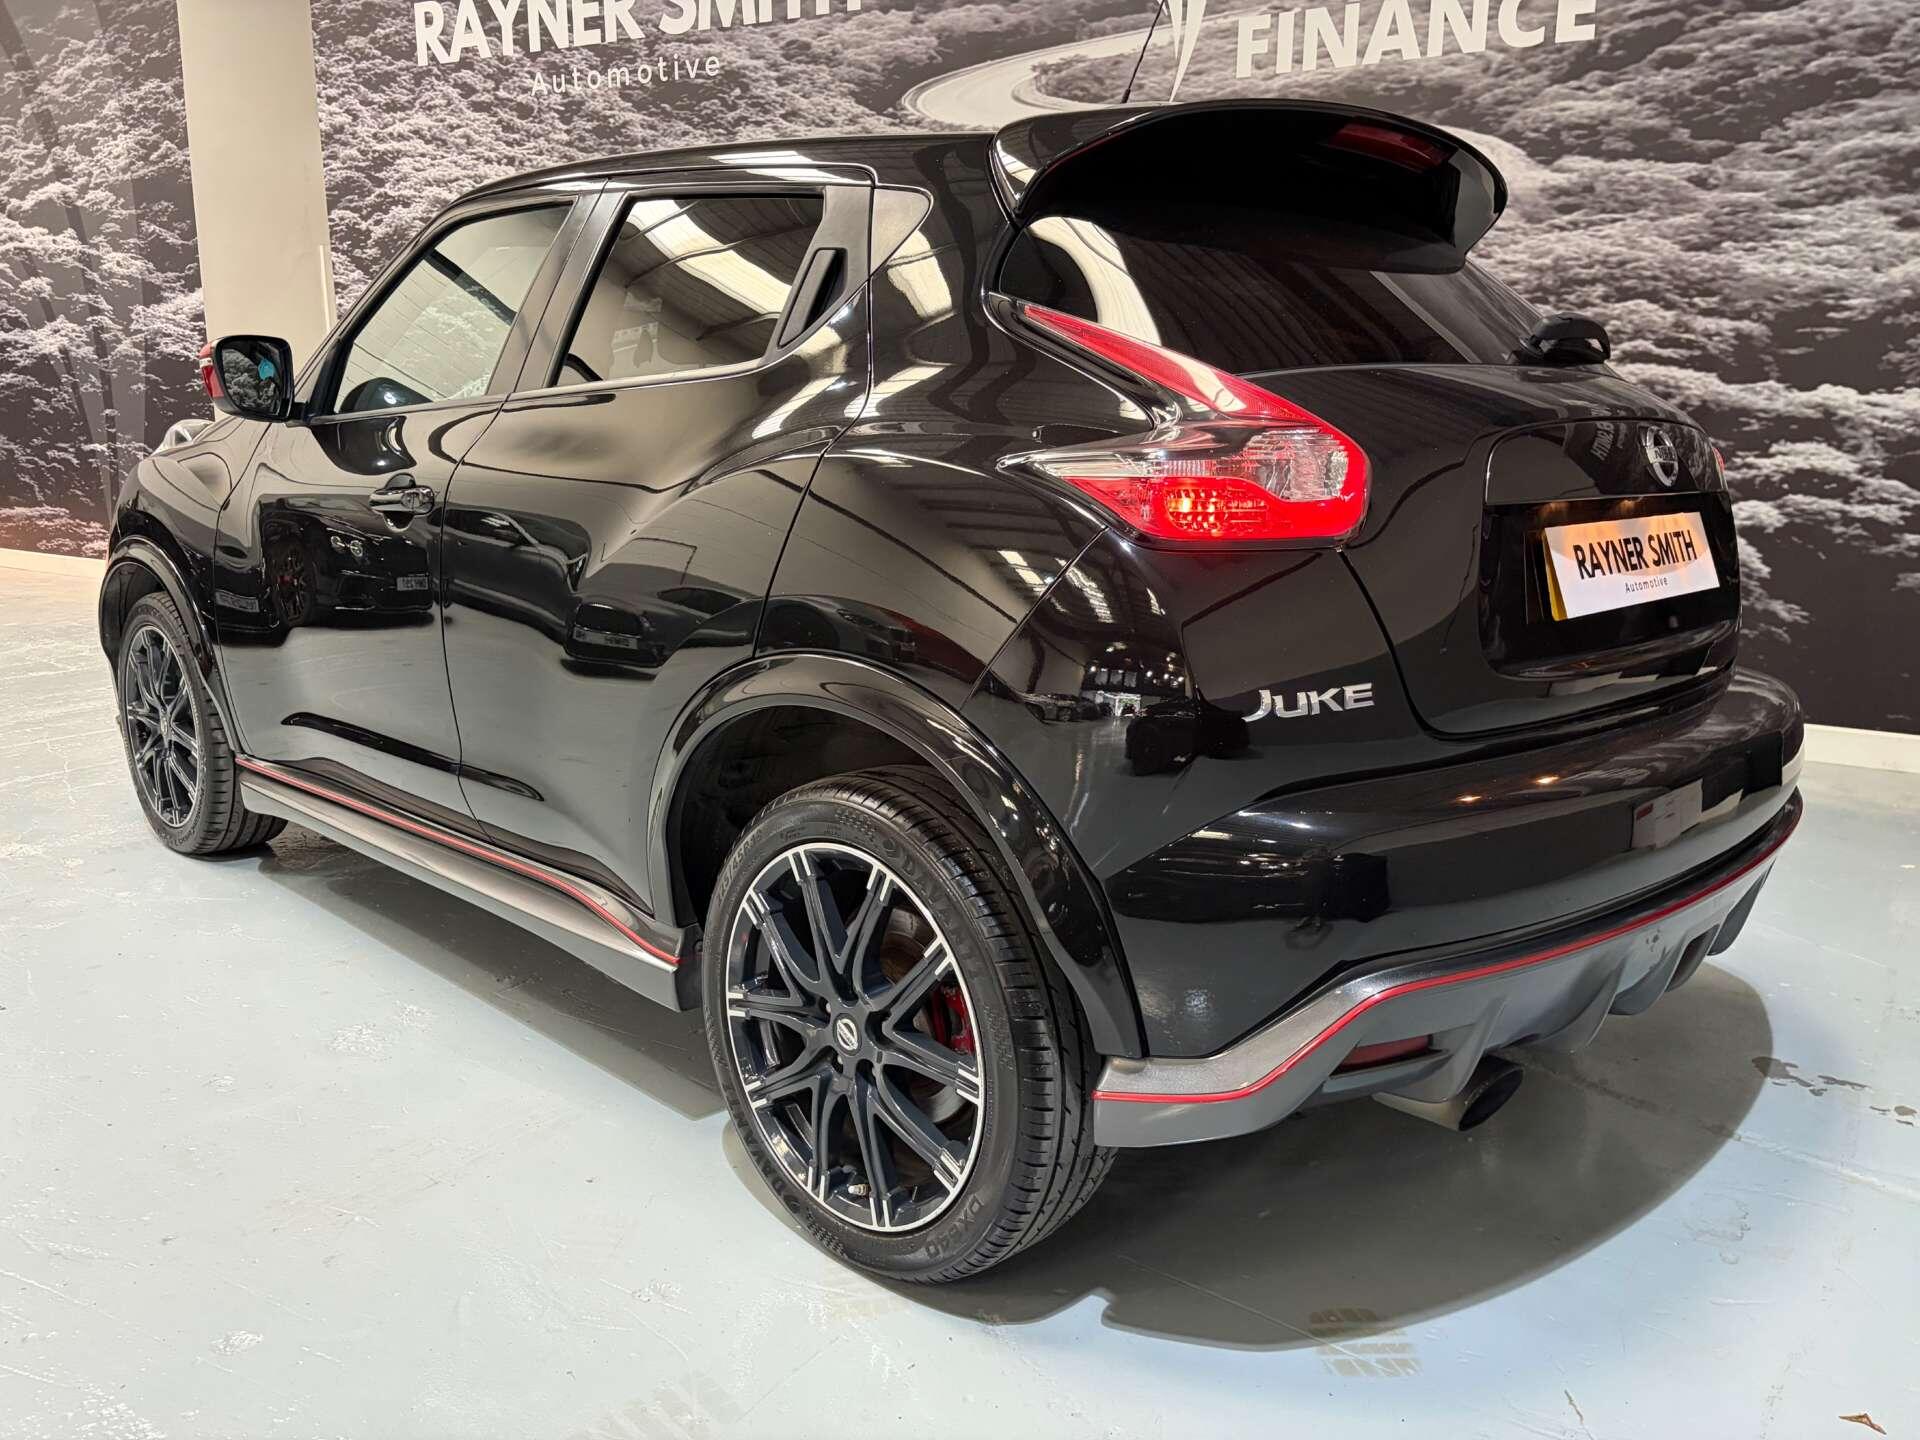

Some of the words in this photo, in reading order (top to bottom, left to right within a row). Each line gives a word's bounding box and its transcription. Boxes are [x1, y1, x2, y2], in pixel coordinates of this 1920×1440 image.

[414, 0, 645, 66] RAYNER
[1236, 0, 1596, 78] FINANCE
[531, 53, 720, 96] Automotive
[1573, 536, 1649, 580] RAYNER
[1648, 530, 1698, 567] SMITH
[1625, 577, 1668, 593] Automotive
[1241, 682, 1375, 722] JUKE
